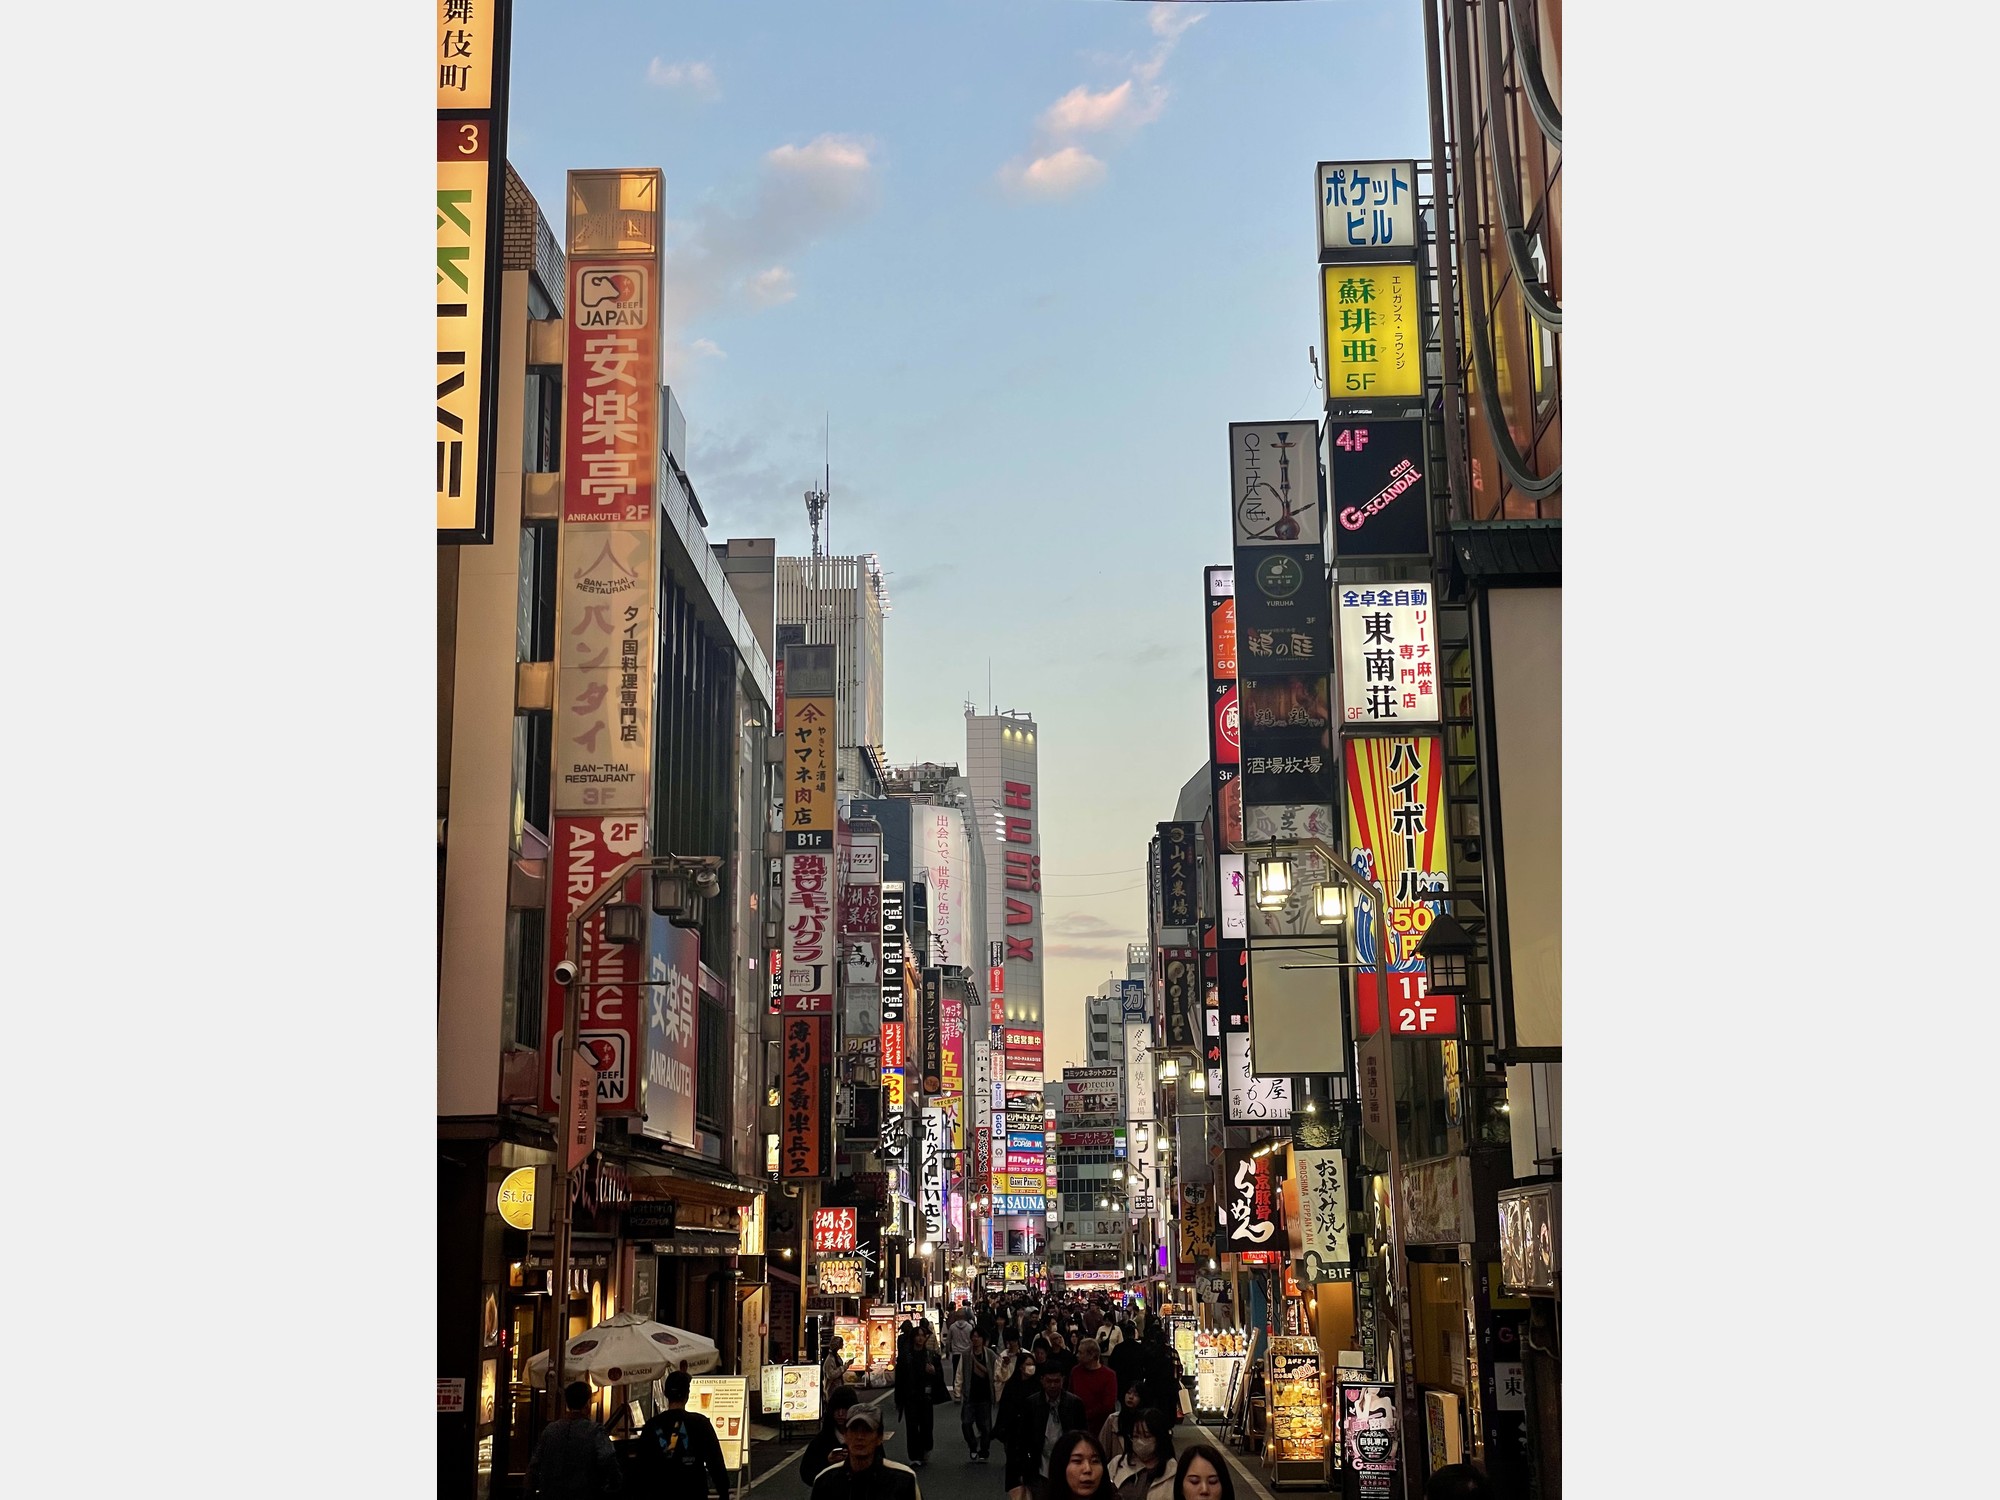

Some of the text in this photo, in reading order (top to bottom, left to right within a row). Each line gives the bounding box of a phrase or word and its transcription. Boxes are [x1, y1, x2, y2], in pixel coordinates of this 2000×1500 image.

[458, 124, 478, 154] 3
[1326, 168, 1408, 207] ポケット
[1347, 209, 1393, 246] ビル
[616, 301, 639, 309] BEEF
[580, 309, 643, 327] JAPAN
[1337, 278, 1379, 364] 蘇琲亜
[1392, 275, 1405, 370] エレガンス・ラウンジ
[1346, 373, 1377, 391] 5F
[580, 334, 640, 506] 安楽亭
[1335, 428, 1369, 451] 4F
[1389, 459, 1412, 478] CLUB
[1339, 469, 1422, 531] G-SCANDAL
[567, 505, 649, 522] ANRAKUTEI 2F
[576, 581, 637, 595] RESTAURANT
[583, 577, 629, 588] BAN-THAI
[1343, 590, 1427, 607] 全卓全自動
[1415, 610, 1433, 696] リーチ麻雀
[620, 605, 639, 742] タイ国料理専門店
[1361, 611, 1398, 720] 東南荘
[1399, 643, 1416, 708] 専門店
[571, 604, 615, 754] バンタイ
[1216, 685, 1228, 694] 4F
[1347, 706, 1363, 720] 3F
[573, 763, 629, 773] BAN-THAI
[815, 726, 827, 793] やきとん酒場
[1247, 755, 1323, 775] 酒場牧場
[565, 773, 636, 783] RESTAURANT
[792, 727, 813, 826] ヤマネ肉店
[1219, 770, 1233, 781] 3F
[582, 787, 616, 805] 3F
[610, 823, 638, 842] 2F
[1387, 742, 1427, 904] ハイボール
[797, 833, 822, 846] B1F
[847, 887, 878, 907] 湖南
[848, 907, 878, 925] 菜館
[1170, 949, 1192, 958] 麻雀
[651, 953, 694, 1049] 安楽亭
[796, 996, 821, 1011] 4F
[1399, 1008, 1437, 1031] 2F
[885, 1024, 894, 1067] リフレッシュ
[1006, 1034, 1041, 1046] 全店営業中
[650, 1048, 692, 1098] ANRAKUTEI
[1265, 1079, 1288, 1100] 屋
[1254, 1157, 1272, 1221] 東京豚骨
[1007, 1196, 1046, 1209] SAUNA
[1298, 1159, 1315, 1245] HIROSHIMA TEPPANYAKI
[1313, 1157, 1345, 1252] お好み焼き
[815, 1209, 853, 1229] 湖南
[824, 1231, 853, 1249] 菜館
[1328, 1268, 1351, 1280] B1F
[1198, 1348, 1209, 1356] 4F
[1504, 1377, 1523, 1396] 東
